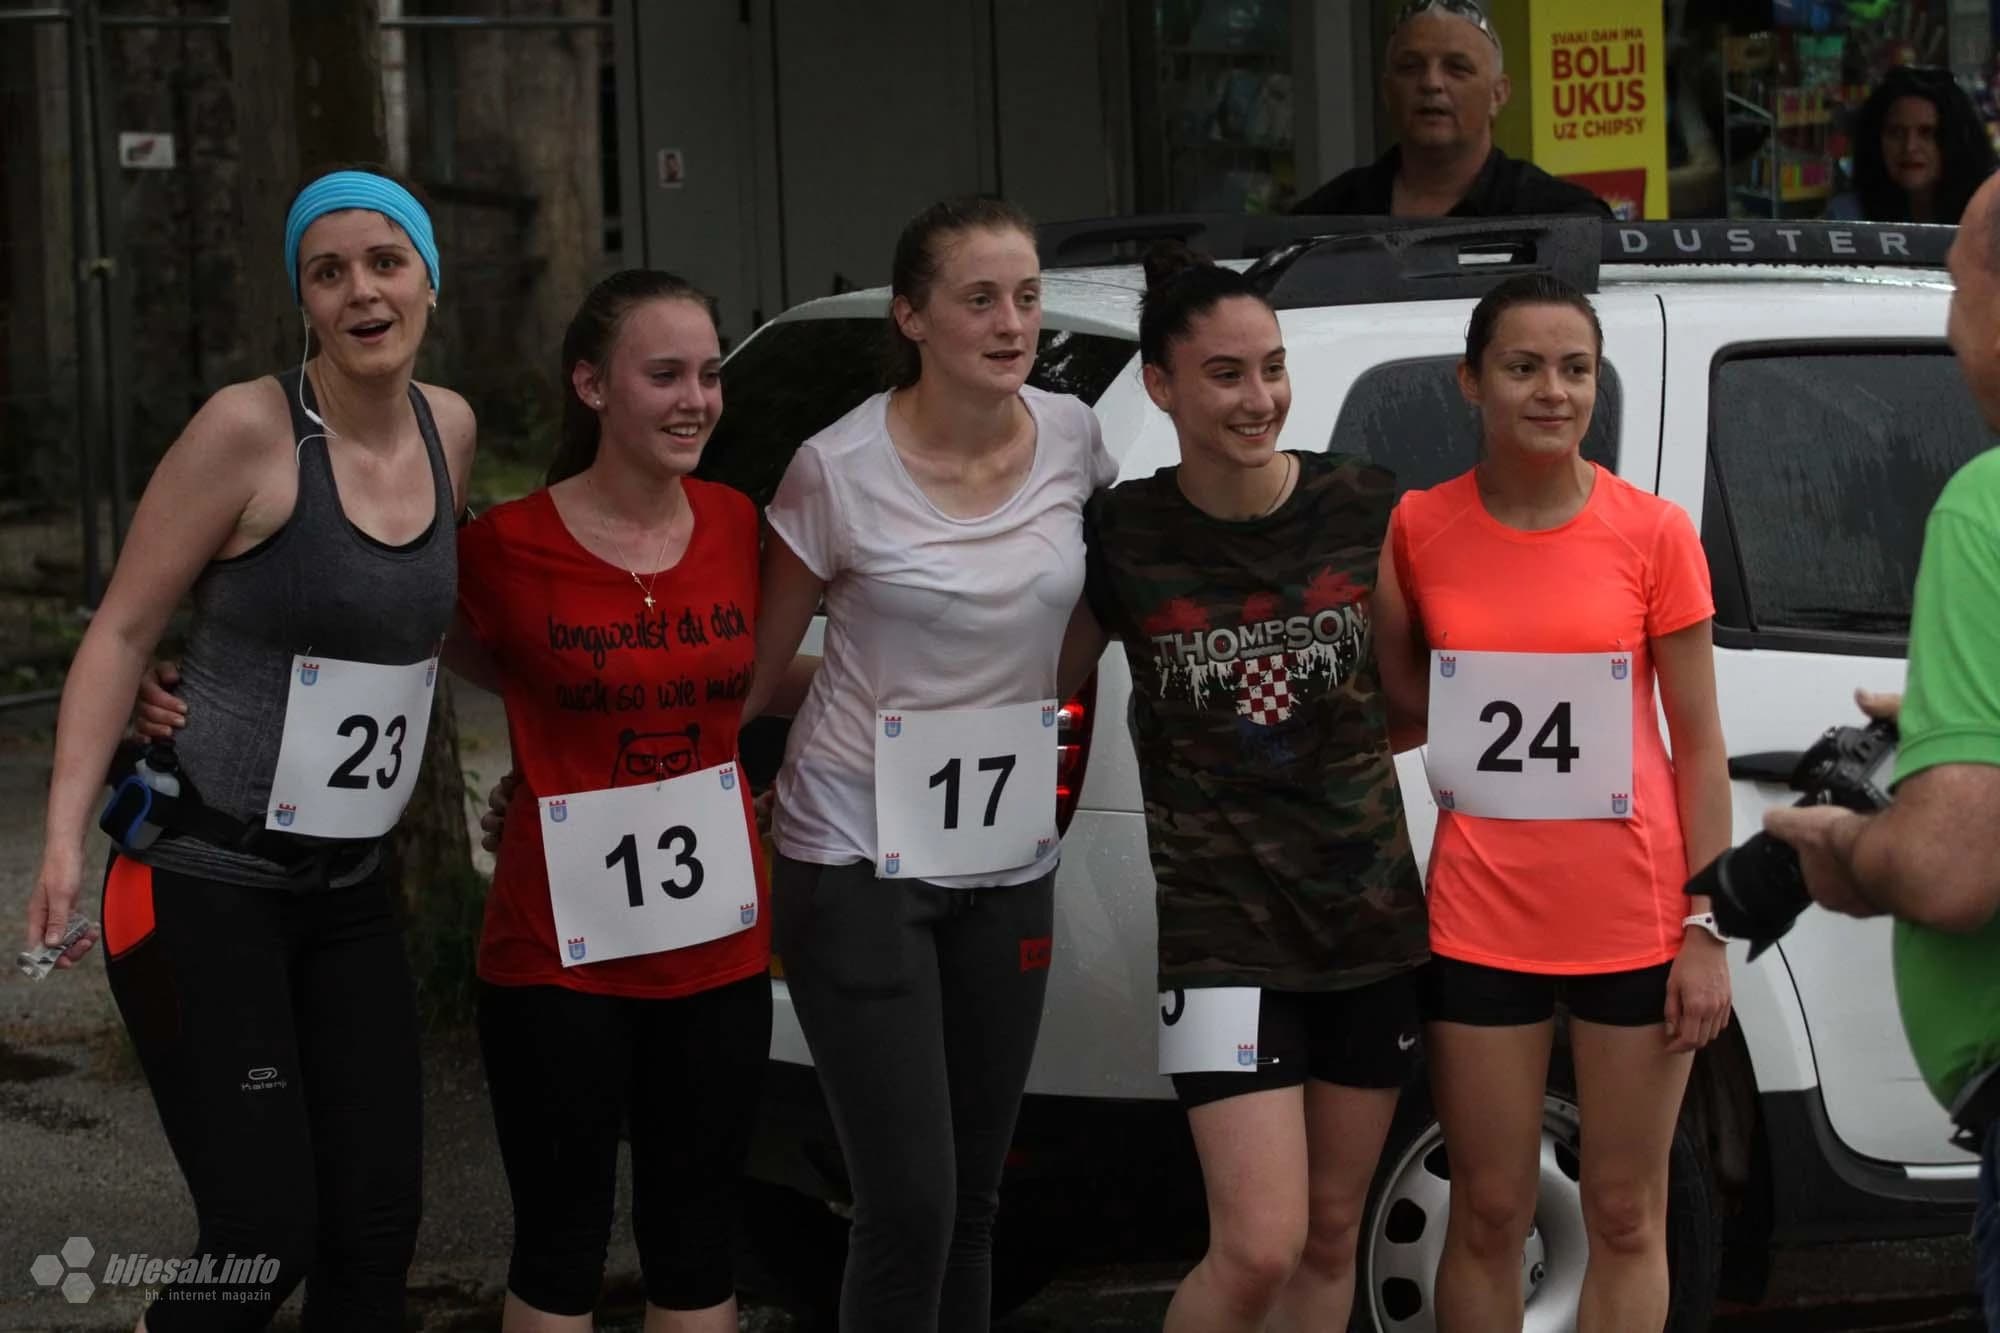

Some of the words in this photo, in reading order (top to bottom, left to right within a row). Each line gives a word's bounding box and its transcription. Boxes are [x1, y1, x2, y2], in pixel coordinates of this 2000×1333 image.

[1552, 44, 1645, 80] BOLJI
[1553, 79, 1645, 117] UKUS
[1553, 123, 1577, 140] UZ
[1583, 117, 1644, 138] CHIPSY
[1620, 228, 1911, 256] DUSTER
[677, 607, 710, 647] du
[1151, 603, 1370, 666] THOMPSON
[616, 683, 645, 711] so
[657, 674, 696, 710] wie
[327, 714, 407, 789] 23
[1477, 700, 1580, 773] 24
[929, 754, 1016, 829] 17
[605, 825, 705, 908] 13
